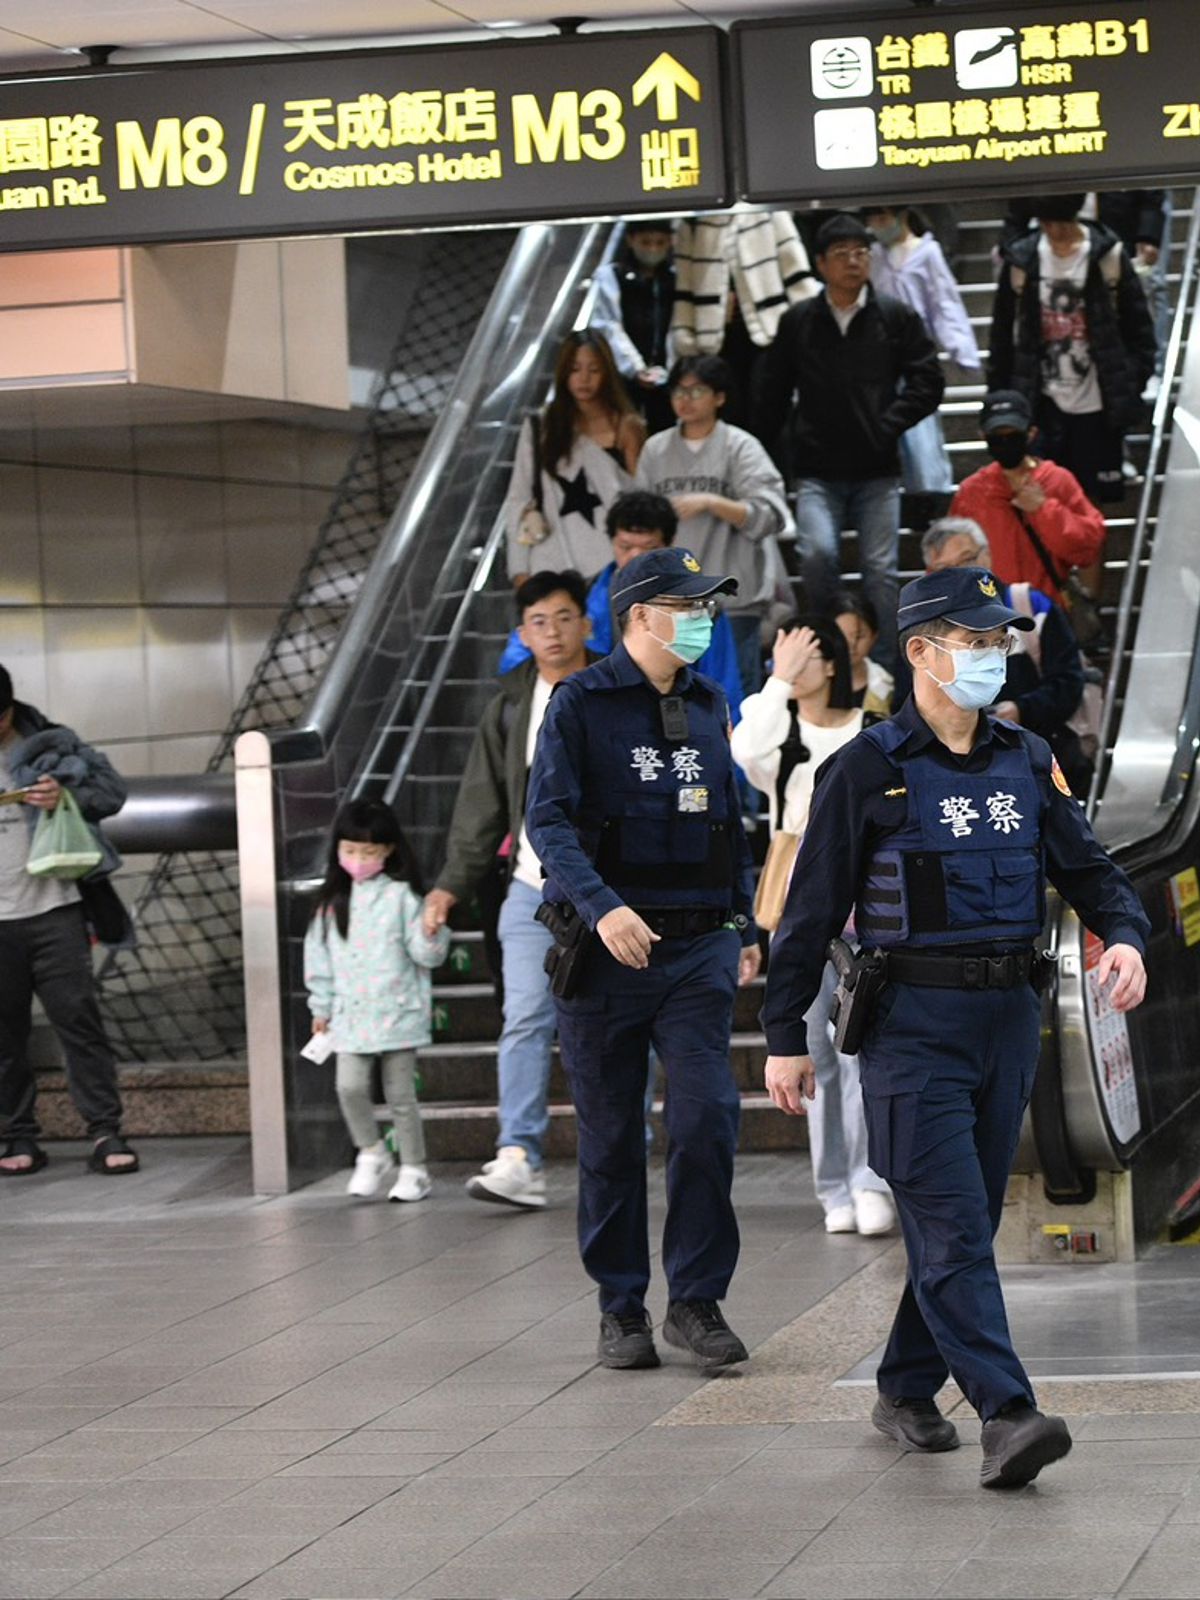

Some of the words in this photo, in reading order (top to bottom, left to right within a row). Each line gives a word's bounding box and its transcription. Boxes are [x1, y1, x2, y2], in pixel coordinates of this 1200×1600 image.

[876, 32, 949, 70] 台鐵
[877, 75, 911, 94] TR
[1021, 63, 1072, 85] HSR
[284, 88, 497, 152] 天成飯店
[512, 90, 626, 164] M3
[878, 92, 1100, 140] 桃園機場捷運
[116, 116, 228, 190] M8
[284, 161, 415, 191] Cosmos
[418, 149, 502, 183] Hotel
[641, 128, 700, 191] 出口
[879, 144, 972, 167] Taoyuan
[974, 136, 1052, 161] Airport
[1054, 131, 1107, 154] MRT
[53, 175, 107, 206] Rd.
[630, 746, 704, 783] 警察
[939, 791, 1024, 838] 警察
